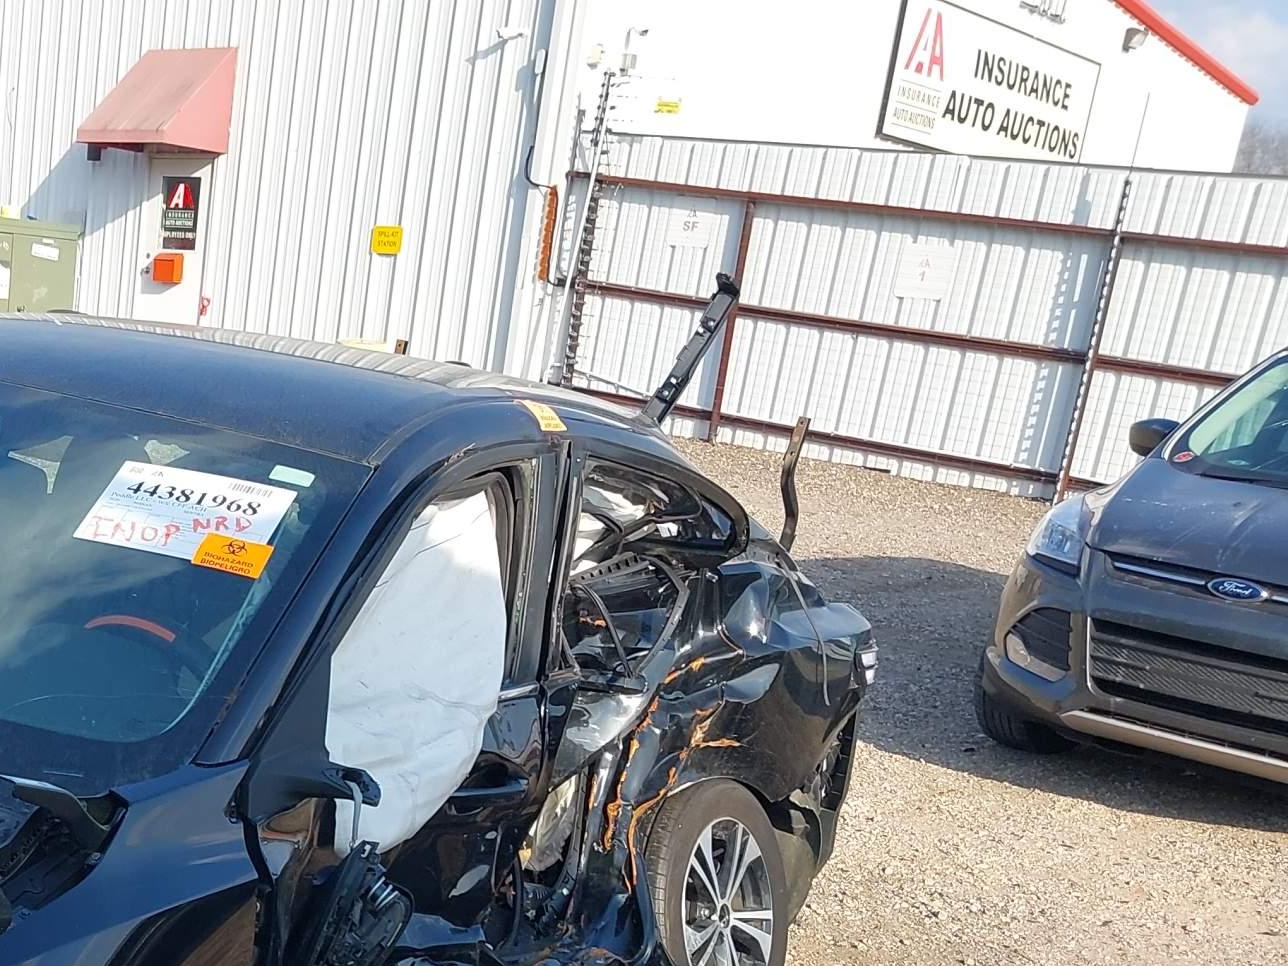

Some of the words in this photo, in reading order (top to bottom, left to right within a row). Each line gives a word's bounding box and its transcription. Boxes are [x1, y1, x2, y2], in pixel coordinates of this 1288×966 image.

[974, 48, 1072, 111] INSURANCE
[897, 85, 940, 108] INSURANCE
[893, 106, 909, 122] AUTO
[909, 111, 936, 129] AUCTIONS
[941, 90, 995, 131] AUTO
[996, 107, 1079, 159] AUCTIONS
[682, 220, 700, 232] SF
[127, 481, 262, 516] 44381968
[92, 515, 181, 547] INOP
[200, 558, 251, 575] BIOPELIGRO
[204, 551, 254, 568] BIOHAZARD
[1218, 580, 1253, 595] Ford
